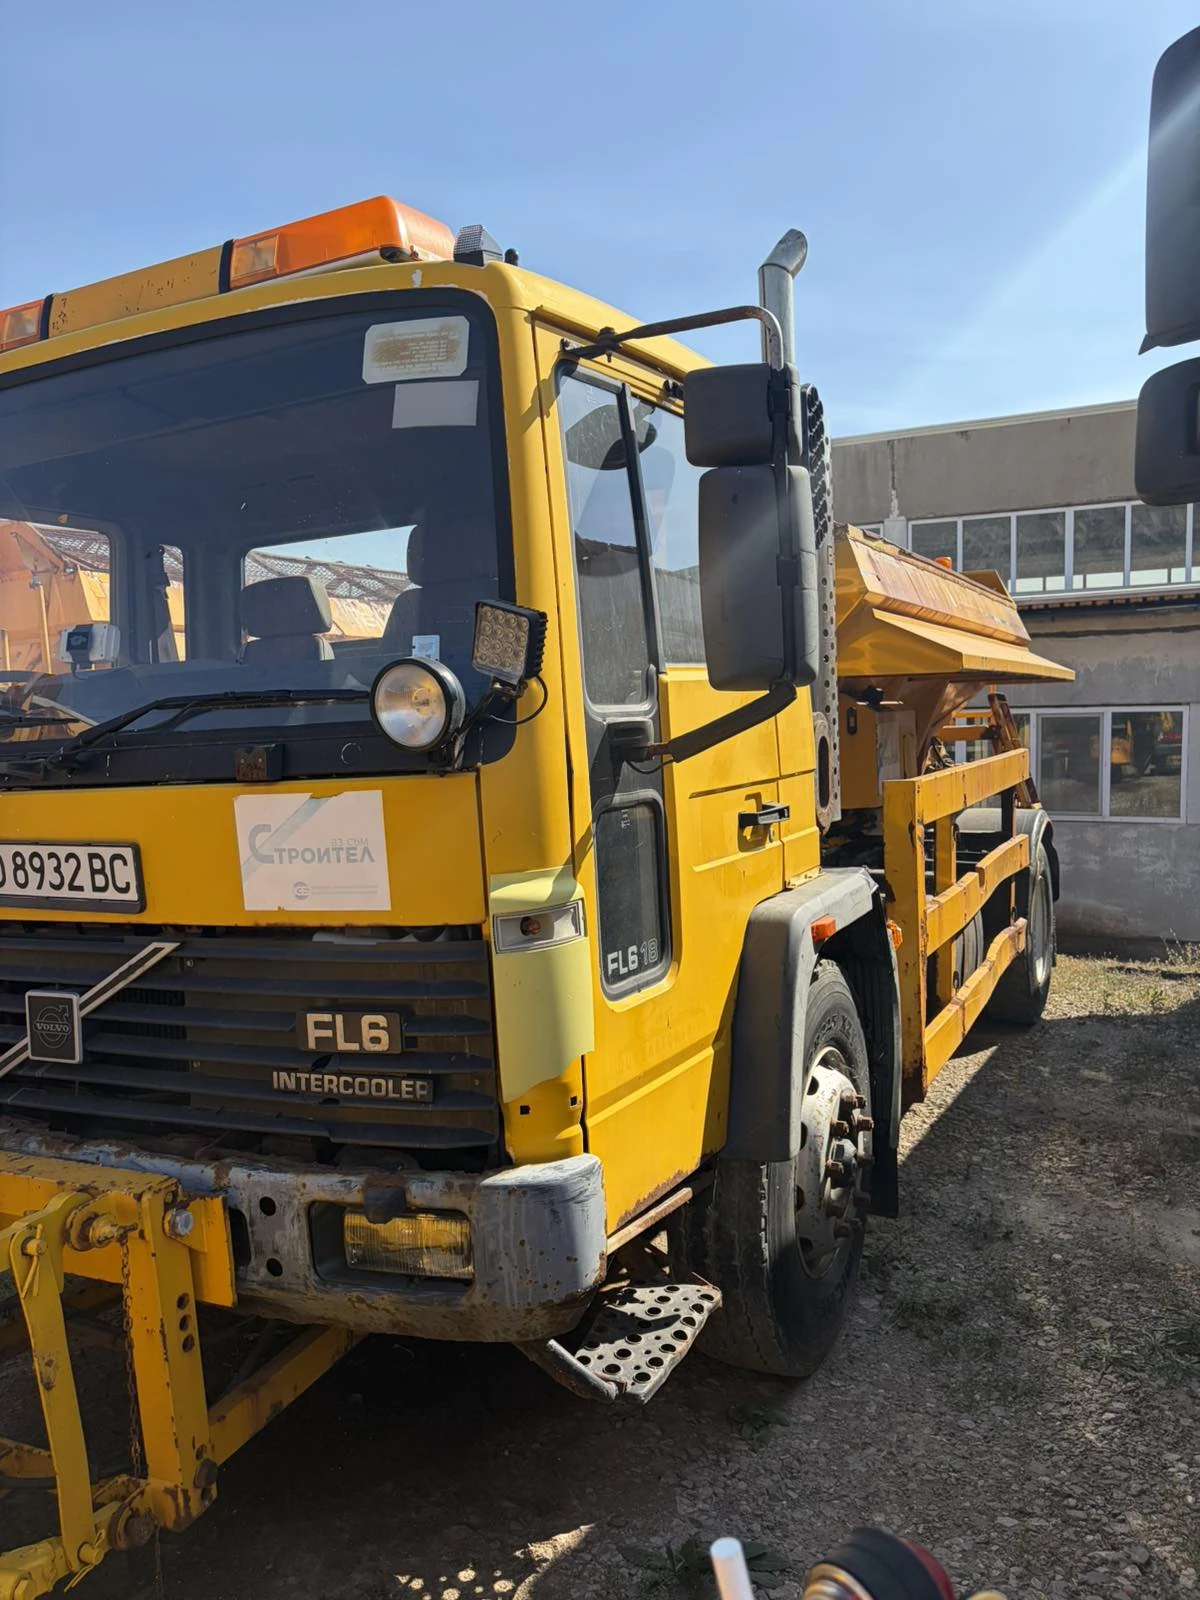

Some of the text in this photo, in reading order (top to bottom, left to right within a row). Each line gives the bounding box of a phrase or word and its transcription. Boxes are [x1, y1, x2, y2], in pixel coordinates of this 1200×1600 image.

[607, 937, 659, 976] FL6 18
[36, 1022, 69, 1033] VOLVO
[306, 1013, 390, 1052] FL6
